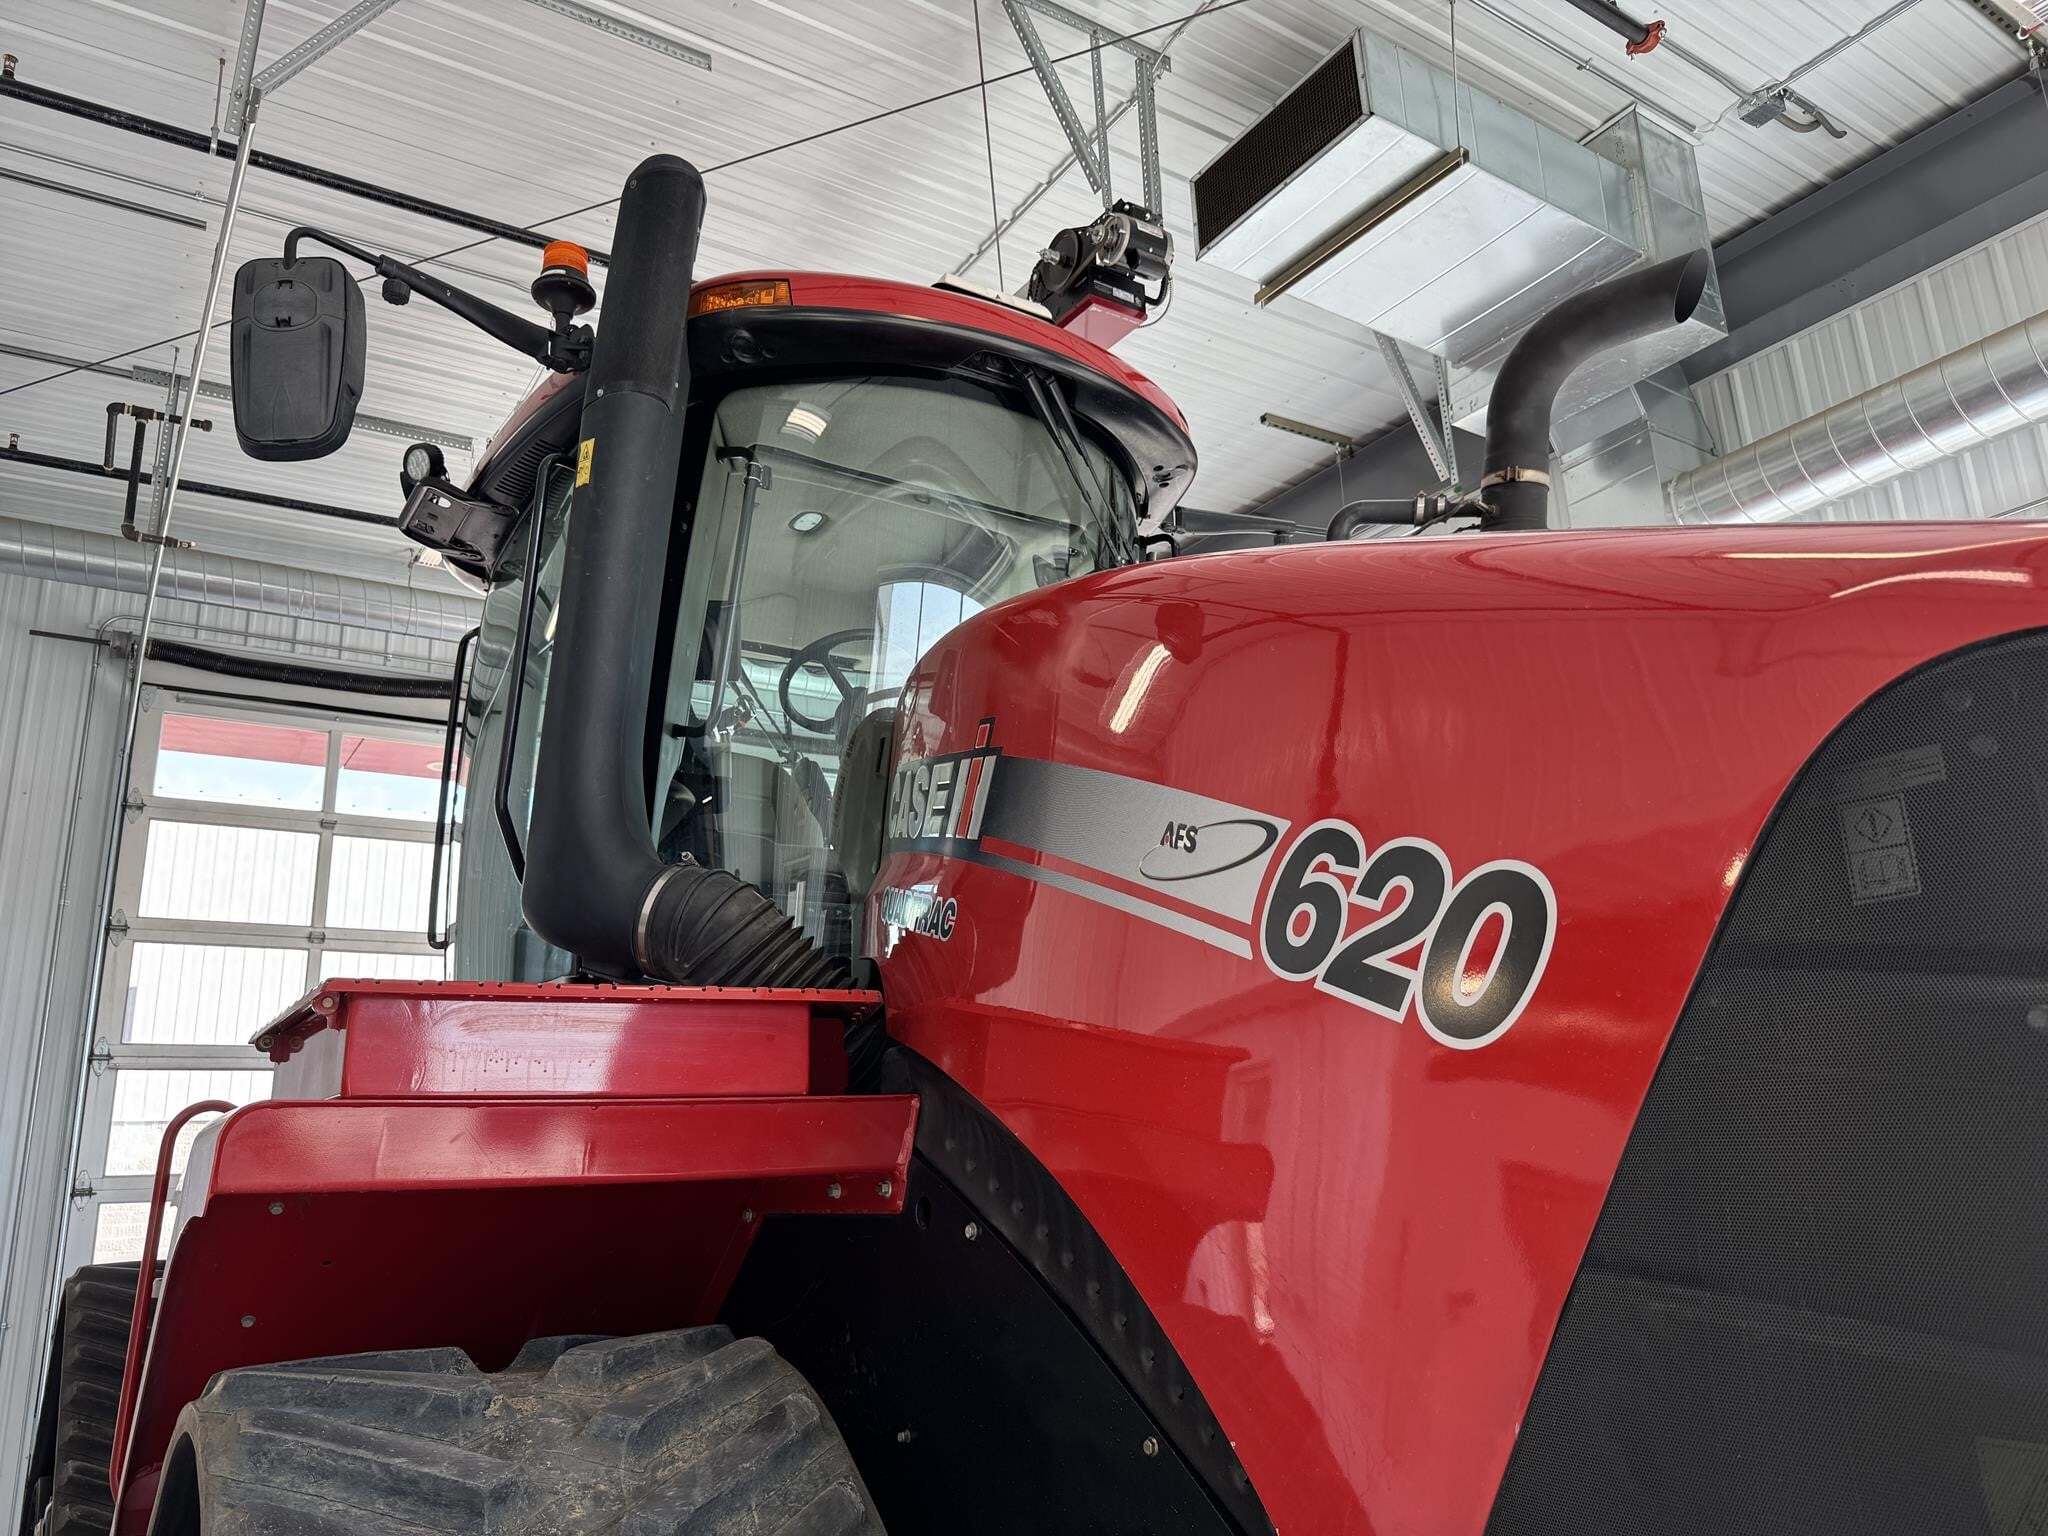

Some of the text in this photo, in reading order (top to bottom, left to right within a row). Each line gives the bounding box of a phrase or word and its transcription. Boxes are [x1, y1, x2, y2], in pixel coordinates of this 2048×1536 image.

[888, 761, 954, 839] CASE
[1160, 821, 1198, 853] AFS
[1261, 819, 1557, 1050] 620
